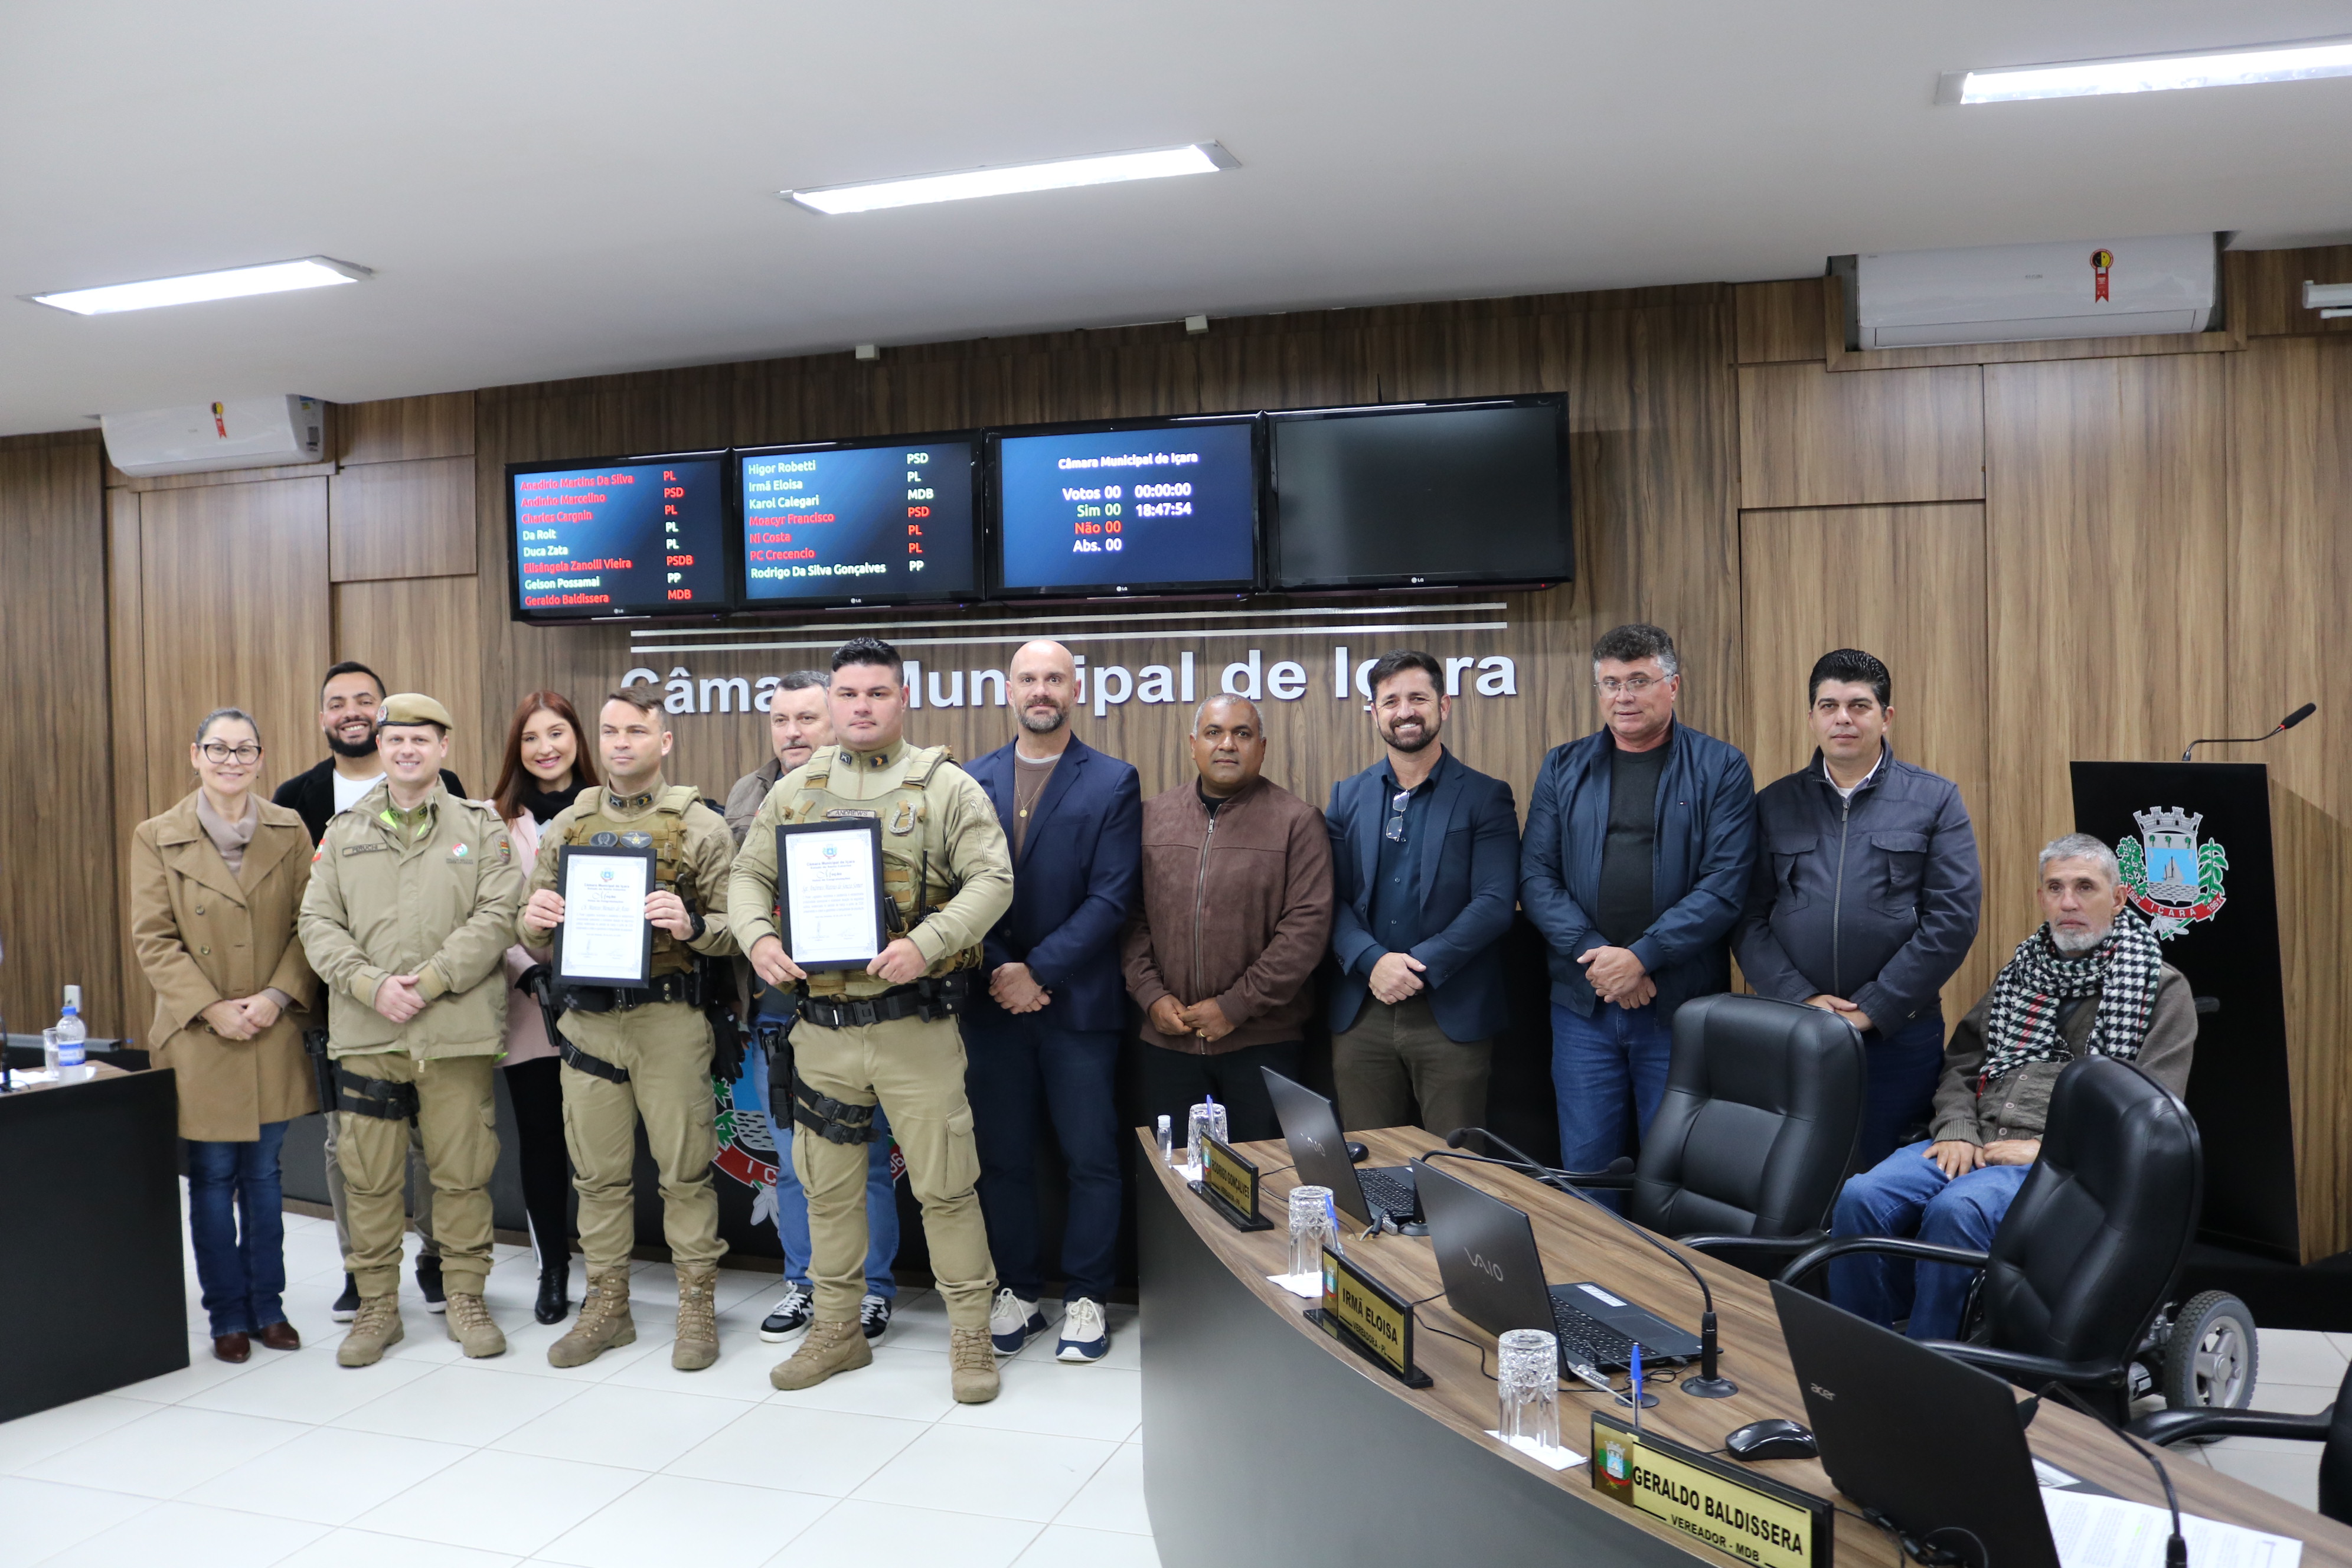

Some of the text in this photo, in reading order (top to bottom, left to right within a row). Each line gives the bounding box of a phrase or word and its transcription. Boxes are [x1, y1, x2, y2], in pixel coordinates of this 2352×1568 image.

[907, 453, 928, 464] PSD
[1059, 453, 1198, 469] Câmara Municipal de Içara
[748, 460, 816, 476] Higor Robetti
[560, 476, 595, 488] Martins
[597, 475, 609, 485] Da
[612, 474, 634, 485] Silva
[663, 471, 676, 481] PL
[907, 471, 921, 482] PL
[664, 487, 684, 498] PSD
[749, 479, 802, 492] Irmã Eloisa
[1063, 485, 1121, 500] Votos 00
[1135, 482, 1191, 497] 00:00:00
[521, 493, 606, 507] Andinho Marcelino
[908, 488, 933, 500] MDB
[749, 495, 819, 509] Karol Calegari
[665, 505, 677, 515] PL
[908, 507, 929, 518] PSD
[1077, 503, 1121, 517] Sim 00
[1136, 502, 1191, 517] 18:47:54
[522, 510, 592, 524] Charles Cargnin
[750, 512, 835, 527] Moacyr Francisco
[665, 522, 678, 532] PL
[908, 525, 922, 535] PL
[1074, 520, 1121, 534] Não 00
[522, 529, 556, 541] Da Rolt
[750, 531, 791, 543] Ni Costa
[524, 545, 568, 557] Duca Zata
[667, 539, 679, 549] PL
[909, 543, 922, 553] PL
[1073, 538, 1122, 553] Abs. 00
[667, 555, 693, 566] PSDB
[750, 548, 815, 560] PC Crecencio
[524, 558, 632, 574] Elisângela Zanolli Vieira
[751, 563, 886, 580] Rodrigo Da Silva Gonçalves
[909, 560, 924, 571] PP
[525, 576, 600, 590] Gelson Possamai
[667, 573, 681, 583] PP
[525, 593, 609, 606] Geraldo Baldissera
[668, 589, 691, 600] MDB
[1221, 649, 1306, 700] de
[2127, 887, 2141, 904] 1924
[2206, 897, 2222, 912] 1961
[1464, 1247, 1503, 1282] VAIO
[1342, 1288, 1398, 1345] IRMÃ ELOISA
[1353, 1321, 1378, 1349] VEREADORA
[1381, 1344, 1387, 1356] PL
[1811, 1383, 1836, 1400] acer
[1633, 1466, 1803, 1556] GERALDO BALDISSERA
[1671, 1514, 1726, 1548] VEREADOR
[1736, 1543, 1759, 1562] MDB
